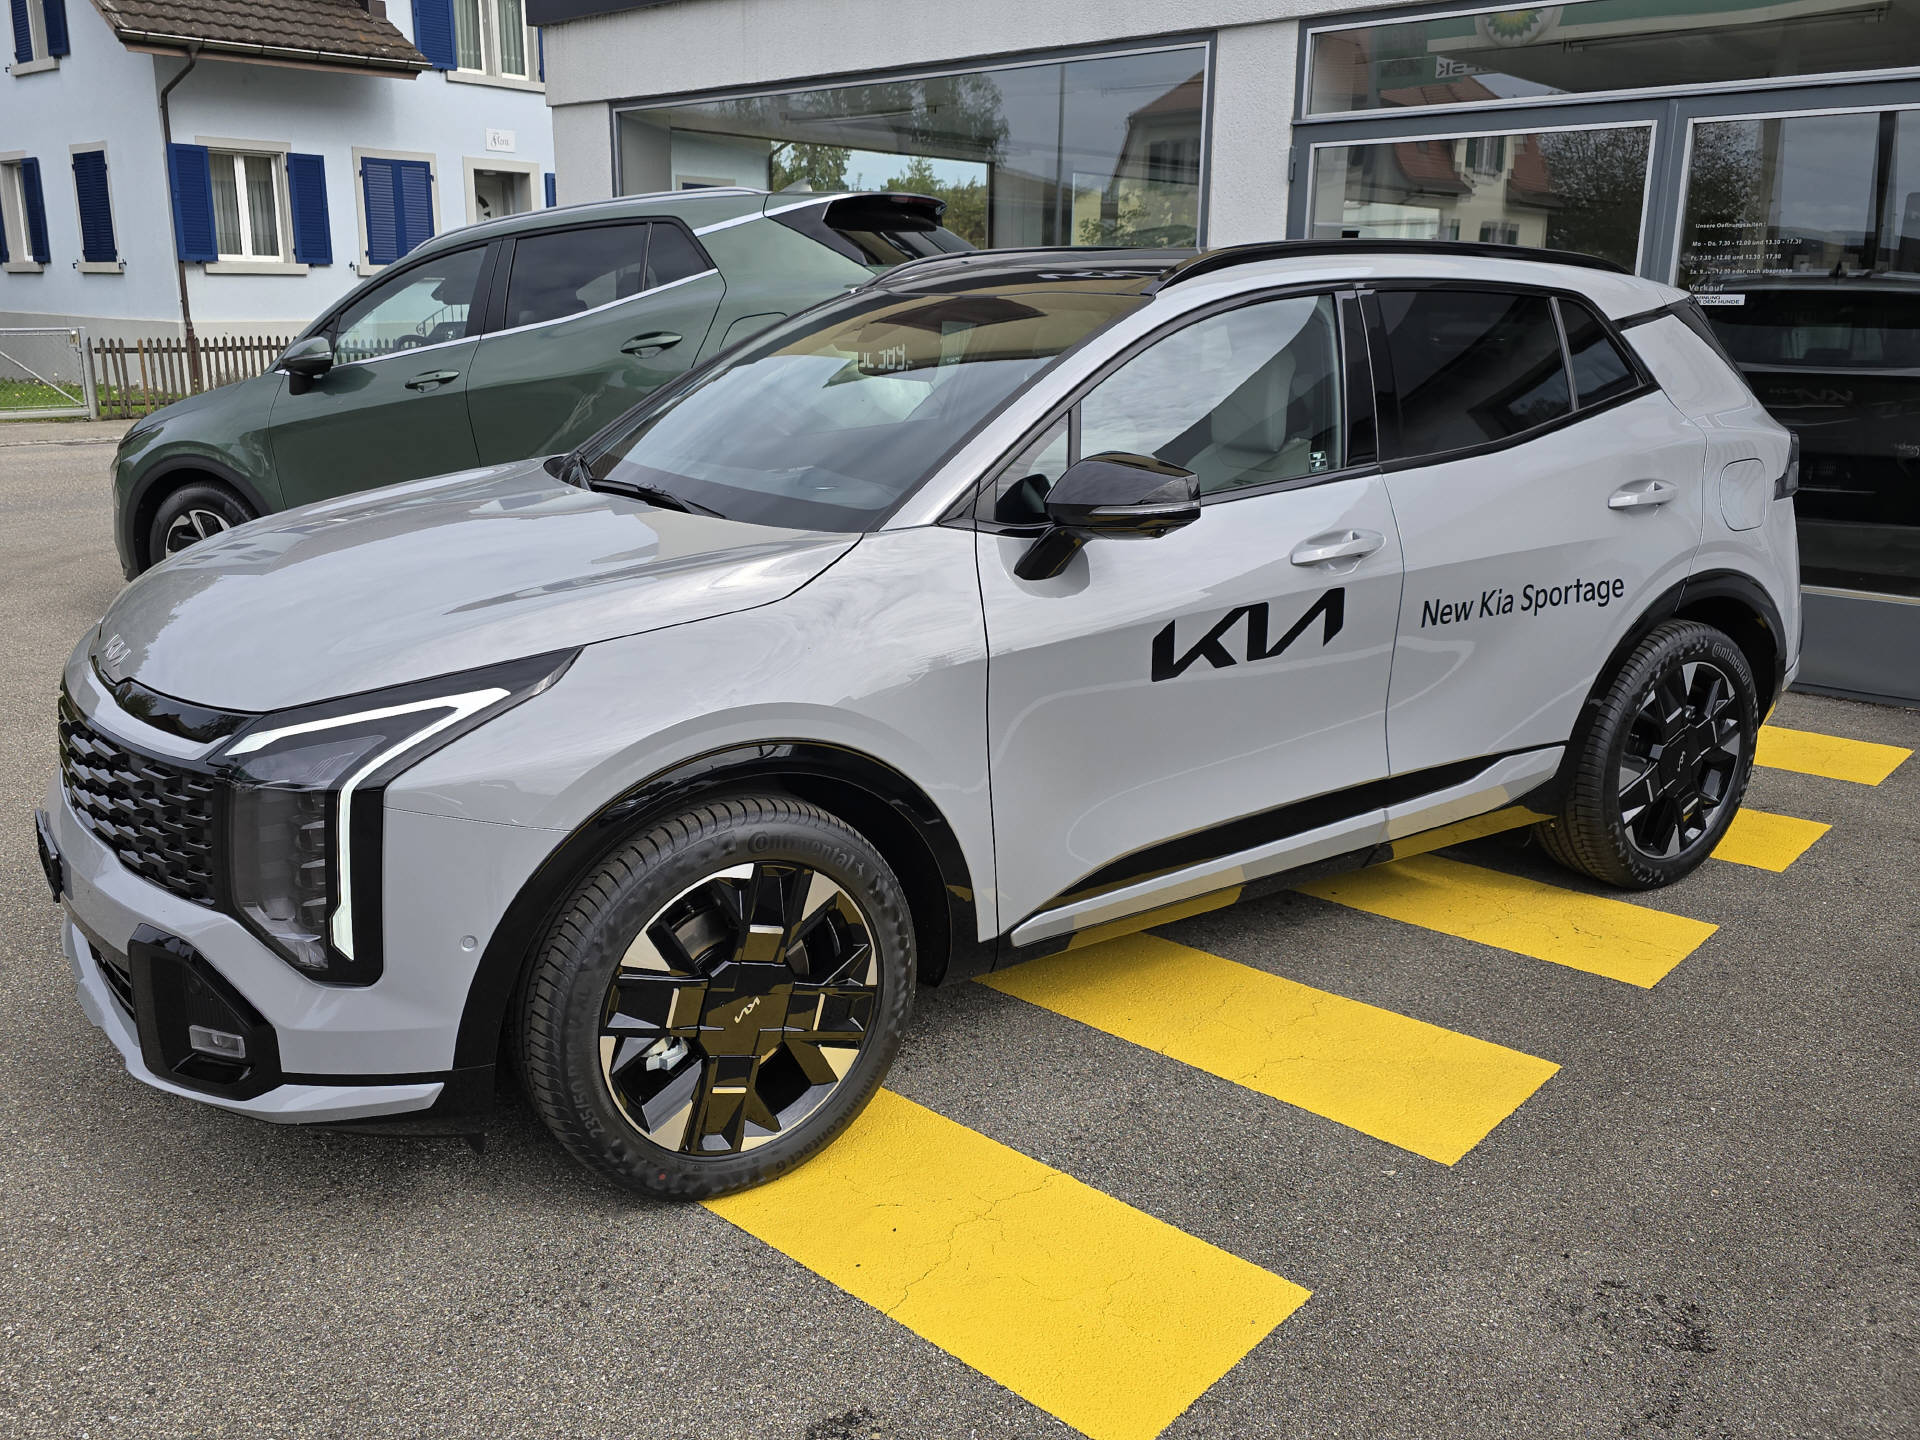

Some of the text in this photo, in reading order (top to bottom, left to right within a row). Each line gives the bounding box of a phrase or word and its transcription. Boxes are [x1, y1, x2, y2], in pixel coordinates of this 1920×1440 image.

[1151, 587, 1346, 683] KIA
[1421, 575, 1625, 628] New Kia Sportage
